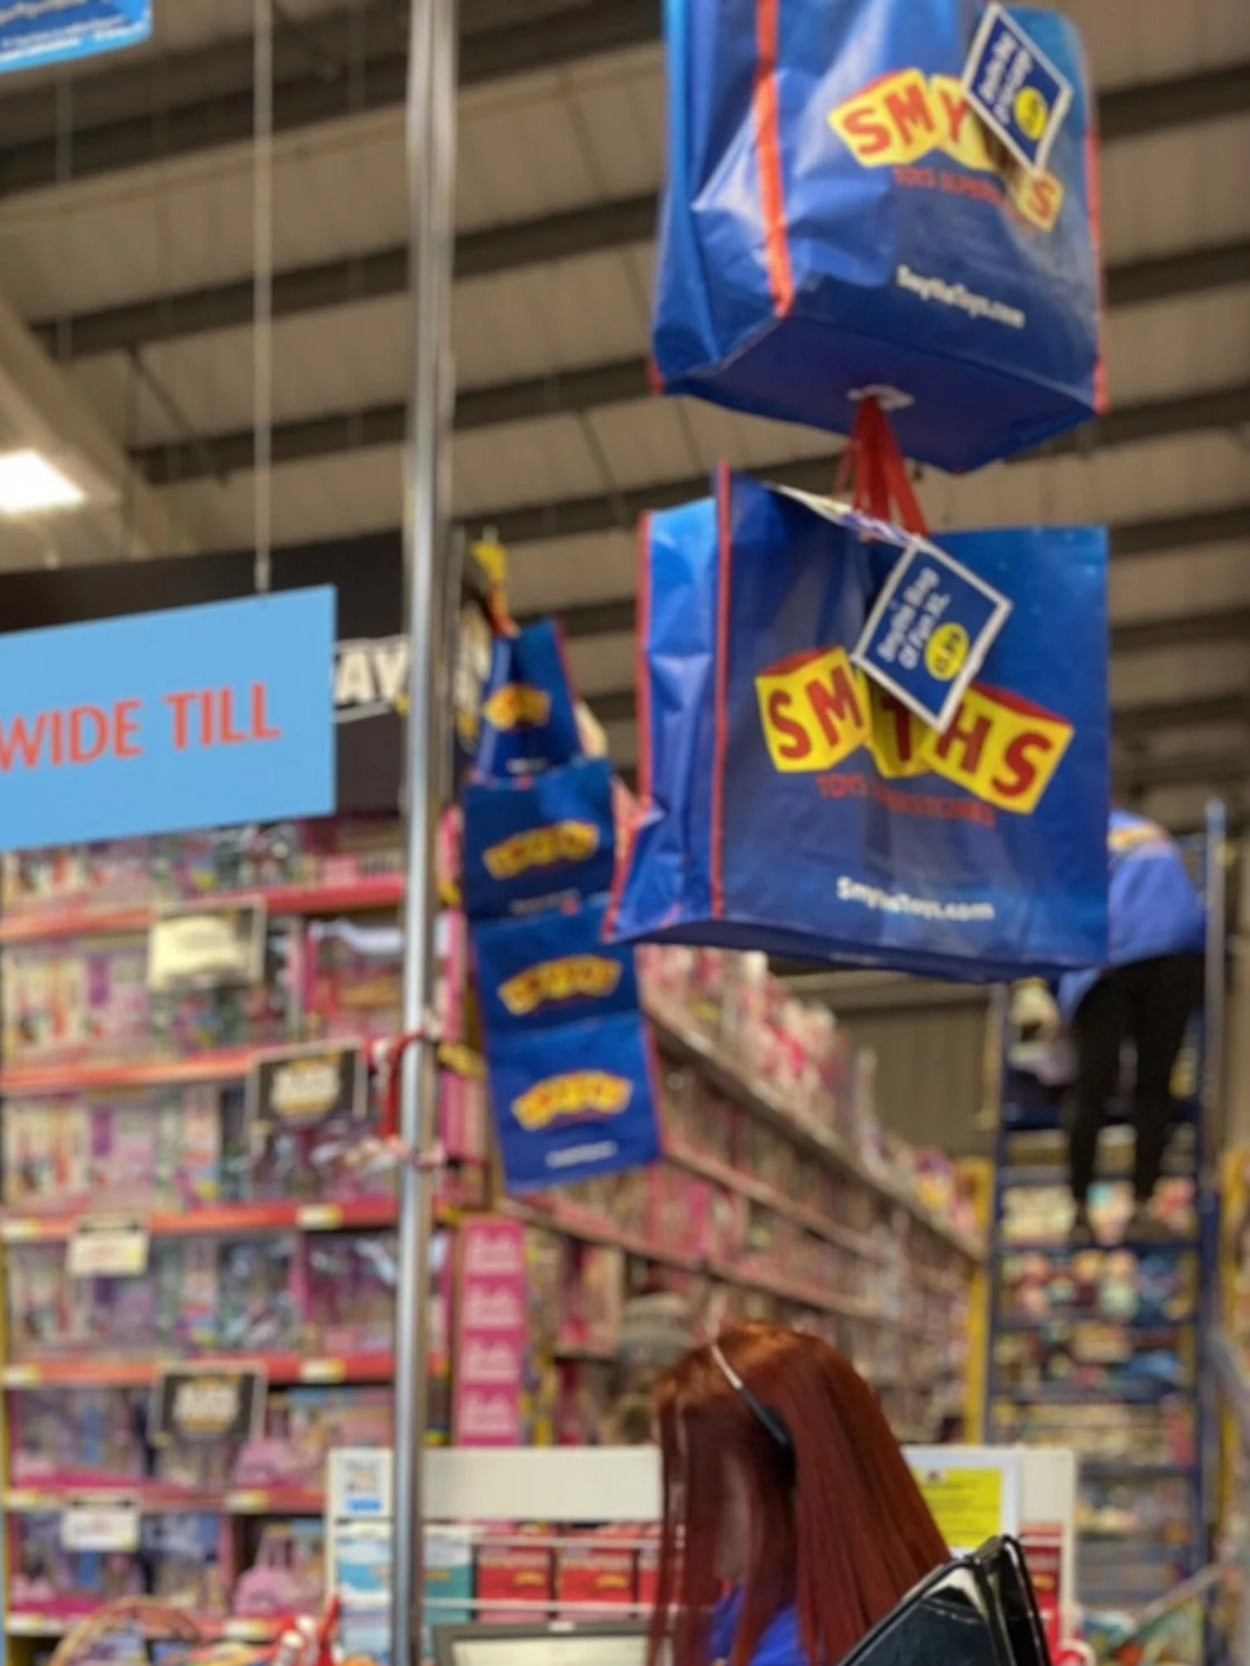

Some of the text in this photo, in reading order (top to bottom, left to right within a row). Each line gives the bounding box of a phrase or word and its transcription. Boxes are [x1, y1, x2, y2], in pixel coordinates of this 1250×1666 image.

[841, 82, 1060, 219] SMYS
[163, 682, 284, 749] TILL
[766, 664, 1054, 800] SMTHS
